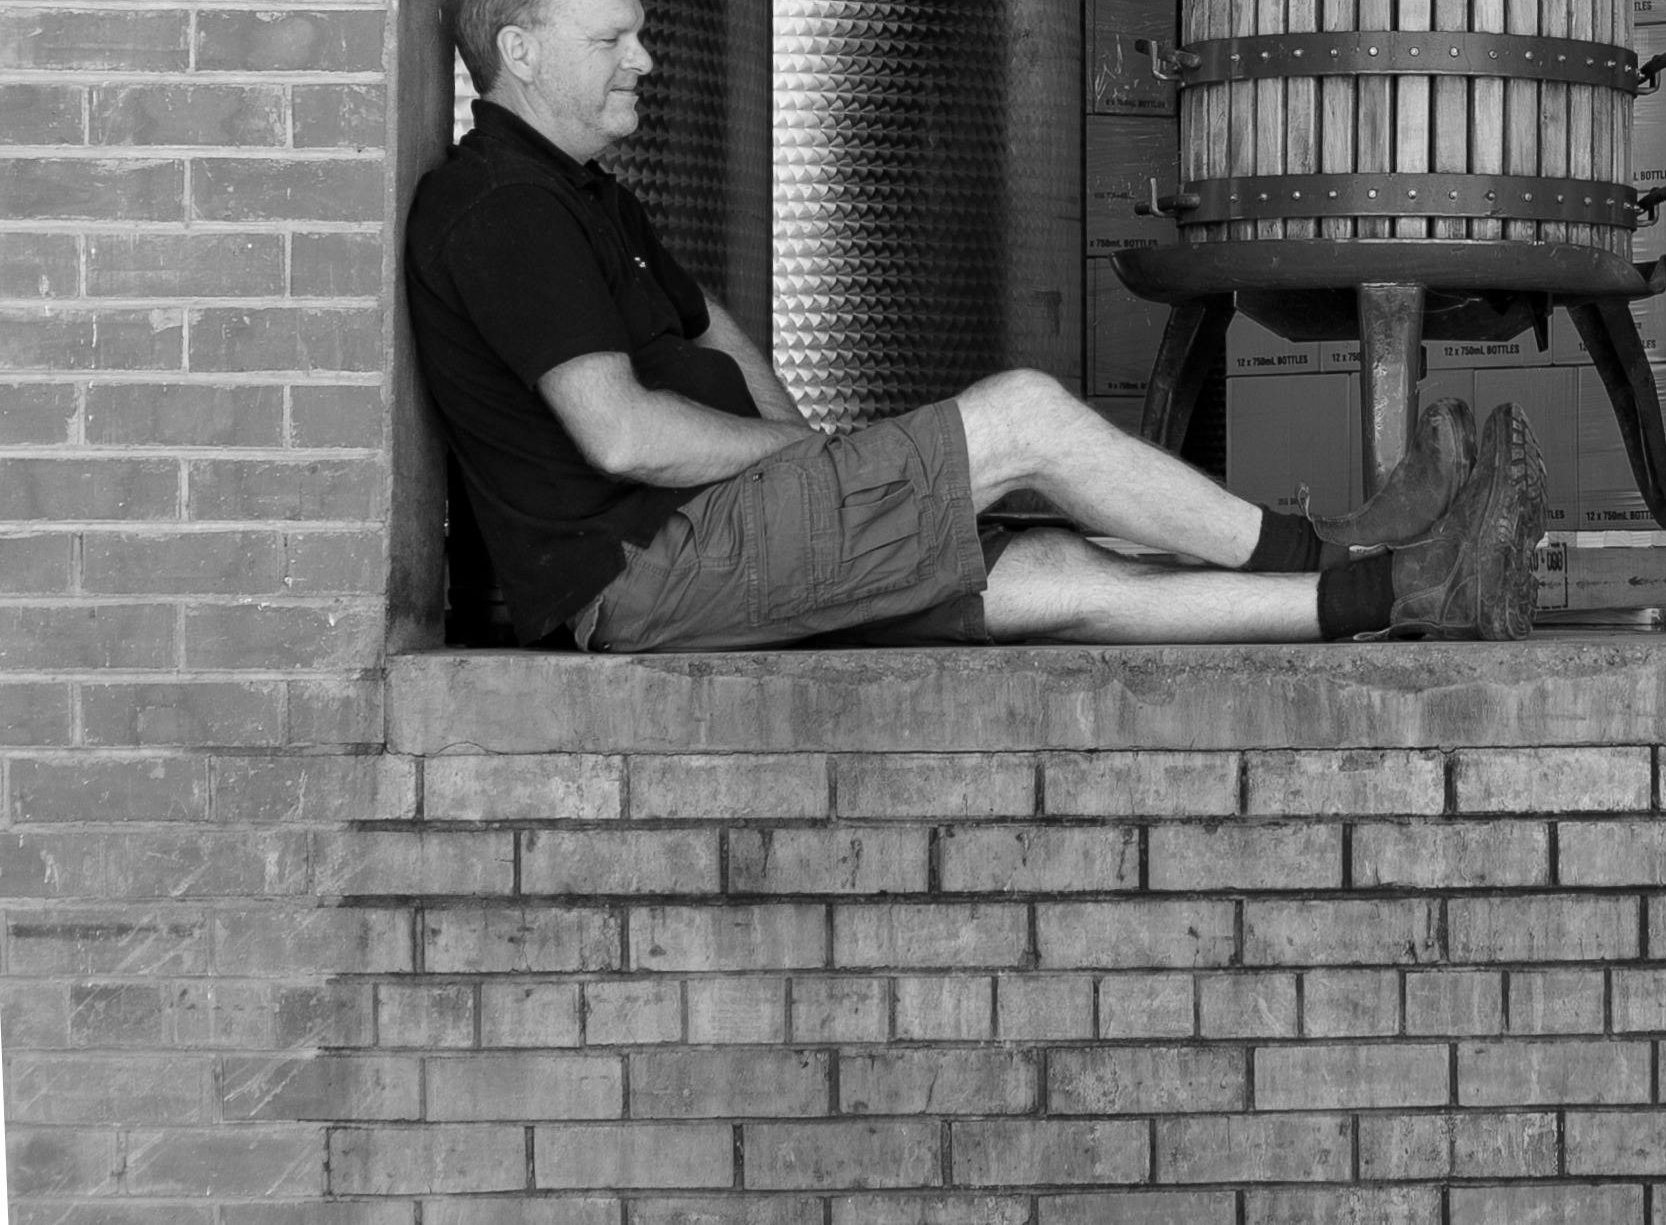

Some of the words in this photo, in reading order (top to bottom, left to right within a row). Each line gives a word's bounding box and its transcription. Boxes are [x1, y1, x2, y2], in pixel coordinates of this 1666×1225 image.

[1460, 346, 1485, 356] 750mL
[1486, 344, 1520, 355] BOTTLES
[1278, 355, 1308, 365] BOTTLES
